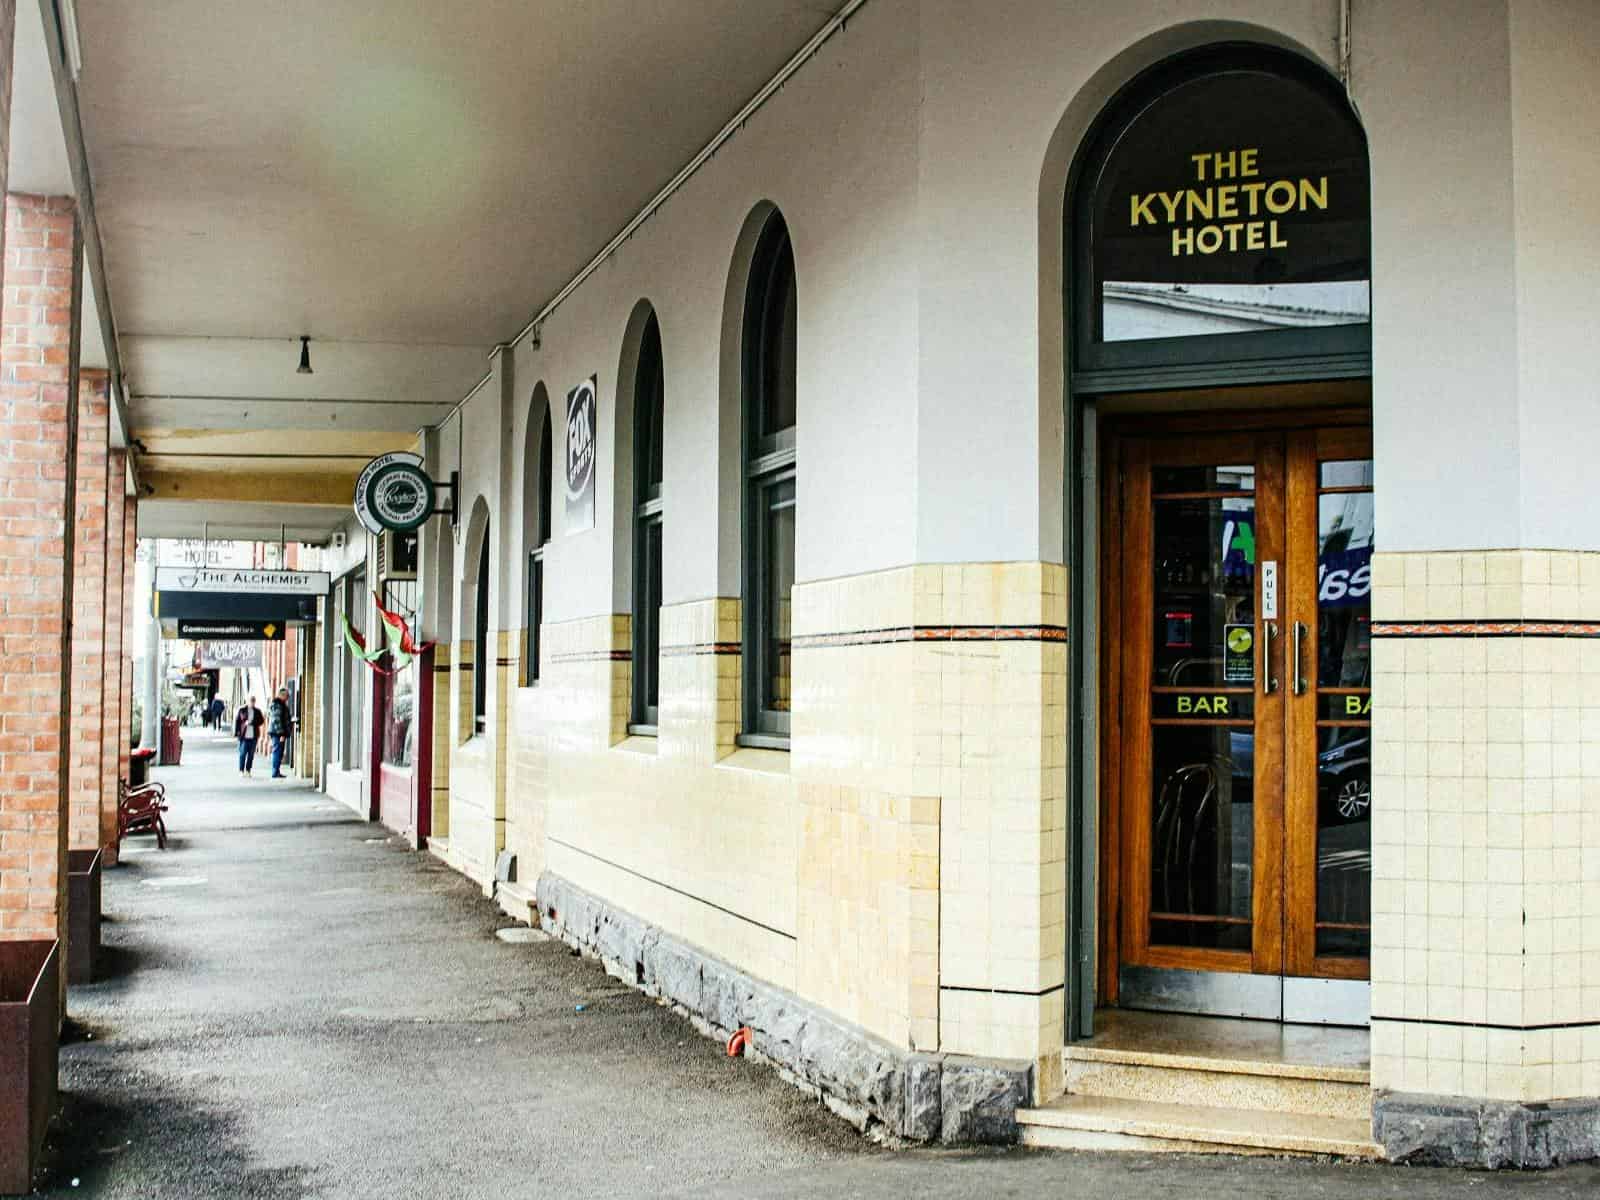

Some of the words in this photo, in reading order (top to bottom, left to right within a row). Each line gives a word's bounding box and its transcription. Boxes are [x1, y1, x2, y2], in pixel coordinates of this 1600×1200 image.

[1191, 148, 1260, 181] THE
[1130, 176, 1328, 227] KYNETON
[1171, 220, 1288, 257] HOTEL
[568, 391, 592, 471] FOX
[368, 455, 395, 473] HOTEL
[184, 550, 223, 564] HOTEL
[201, 572, 228, 583] THE
[233, 572, 310, 585] ALCHEMIST
[1265, 568, 1274, 612] PULL
[1177, 695, 1229, 714] BAR
